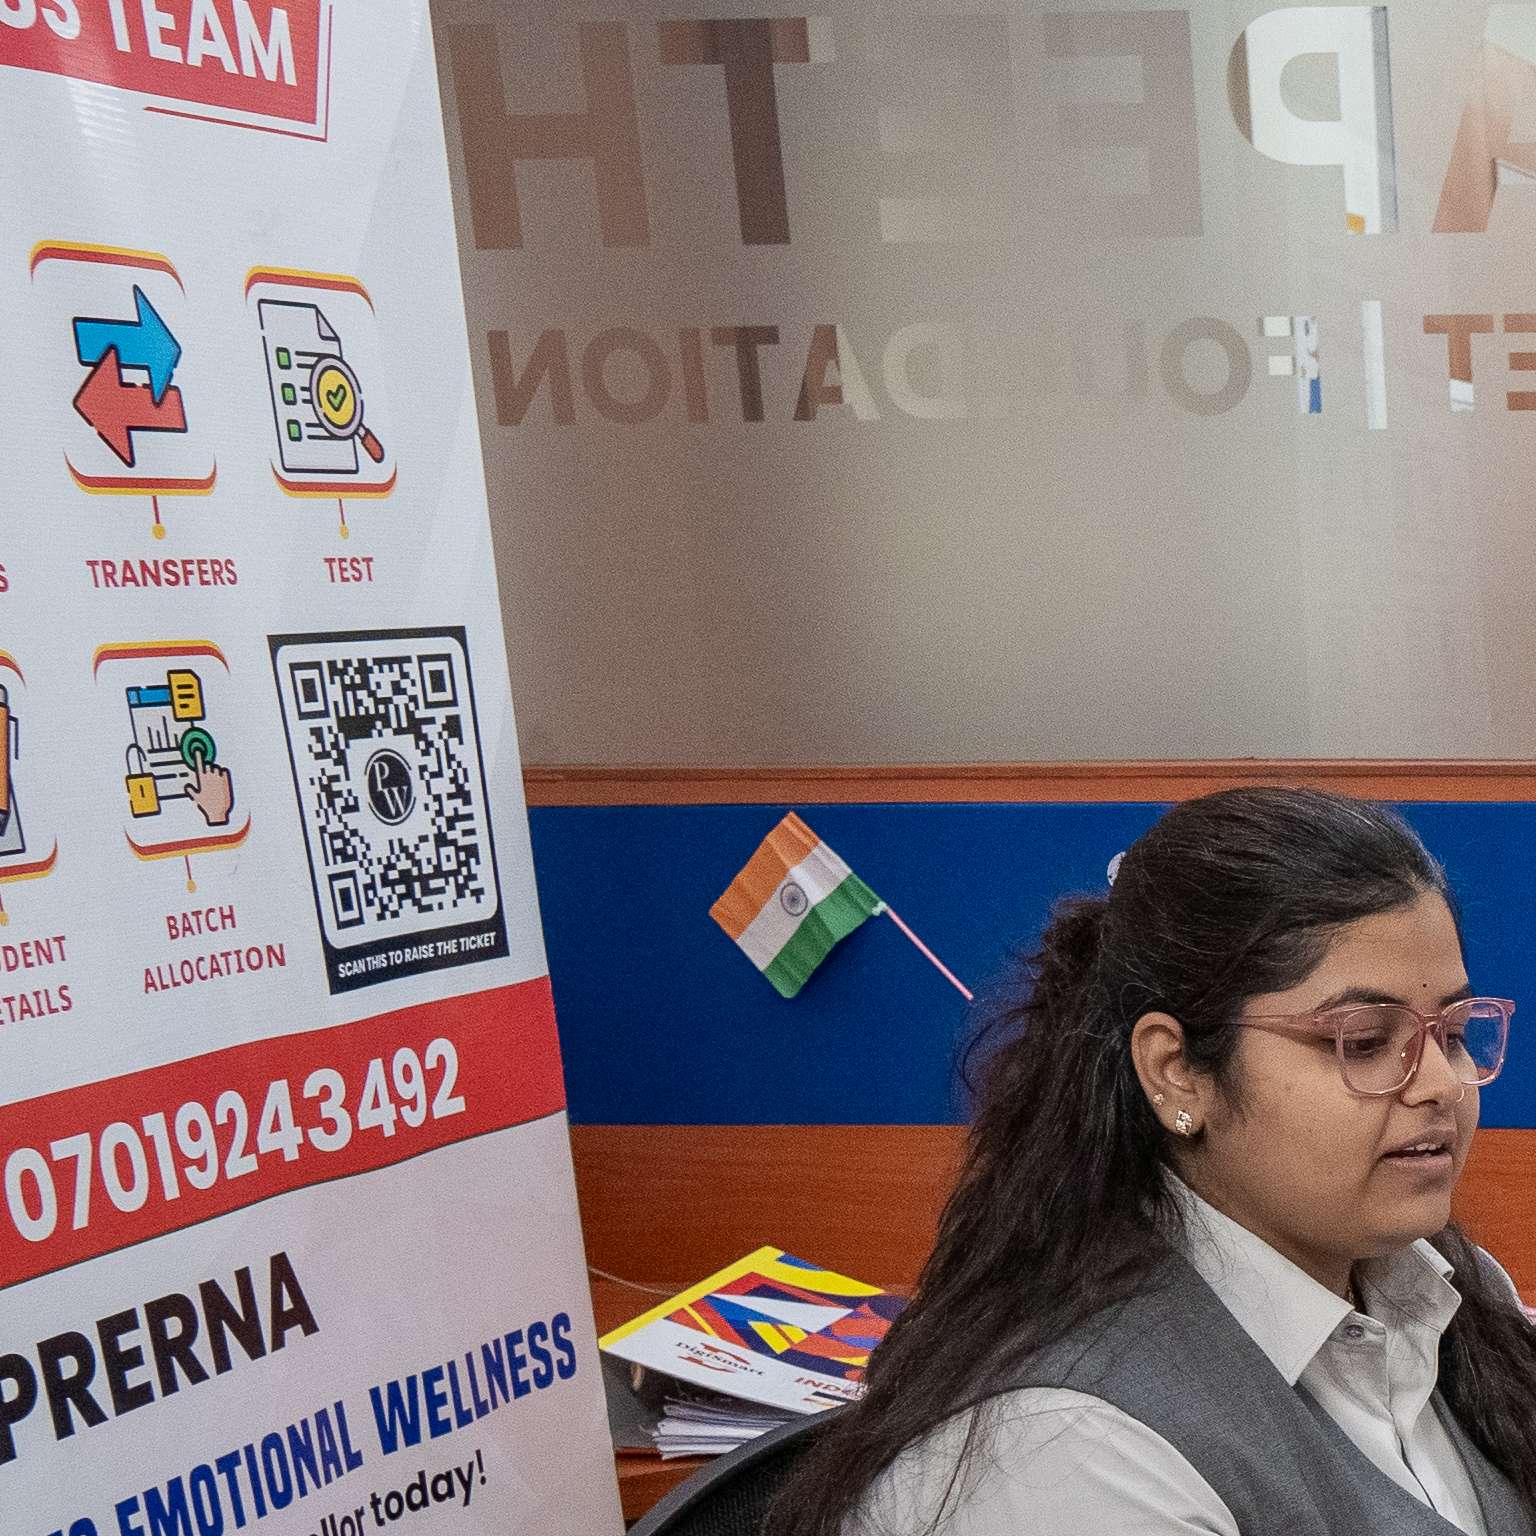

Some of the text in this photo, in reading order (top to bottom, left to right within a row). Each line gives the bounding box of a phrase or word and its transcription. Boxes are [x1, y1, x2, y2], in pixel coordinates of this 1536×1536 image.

[86, 557, 239, 588] TRANSFERS
[324, 557, 374, 583] TEST
[166, 905, 236, 940] BATCH
[143, 944, 286, 993] ALLOCATION
[338, 932, 496, 979] SCAN THIS TO RAISE THE TICKET
[4, 1037, 466, 1242] 07019243492
[0, 1251, 319, 1464] PRERNA
[369, 1312, 577, 1456] WELLNESS
[370, 1449, 488, 1529] today!
